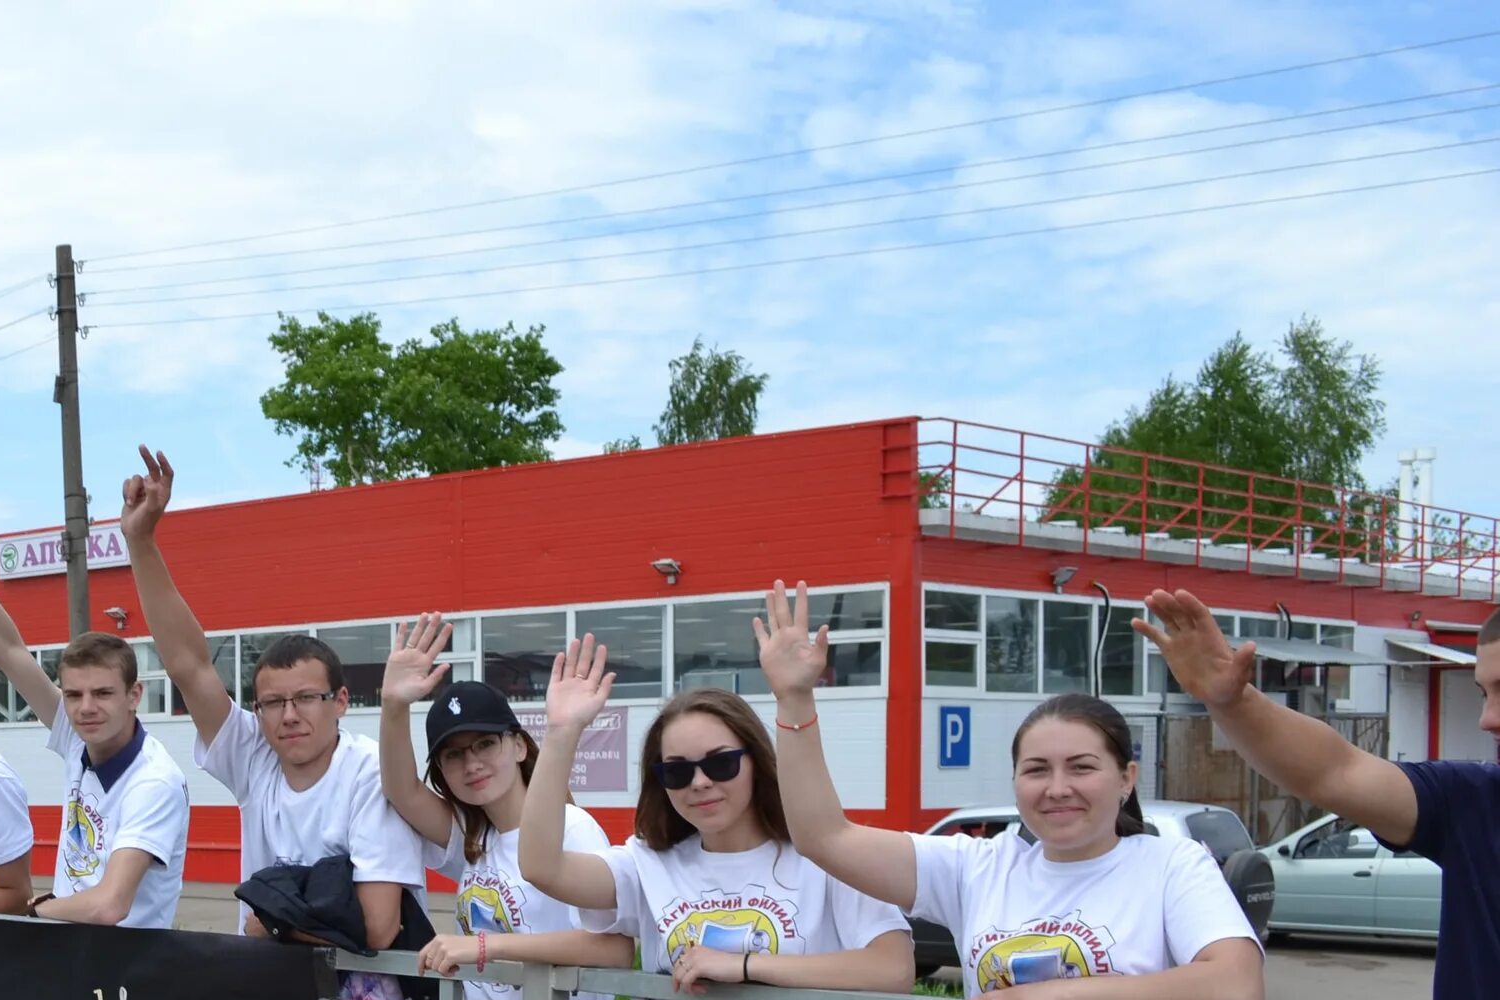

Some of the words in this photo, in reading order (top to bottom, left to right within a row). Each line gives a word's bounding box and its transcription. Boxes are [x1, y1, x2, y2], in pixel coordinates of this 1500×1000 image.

[22, 533, 122, 567] АПКА
[946, 713, 964, 759] P
[747, 897, 796, 939] ФИЛИАЛ
[1061, 921, 1110, 974] ФИЛИАЛ
